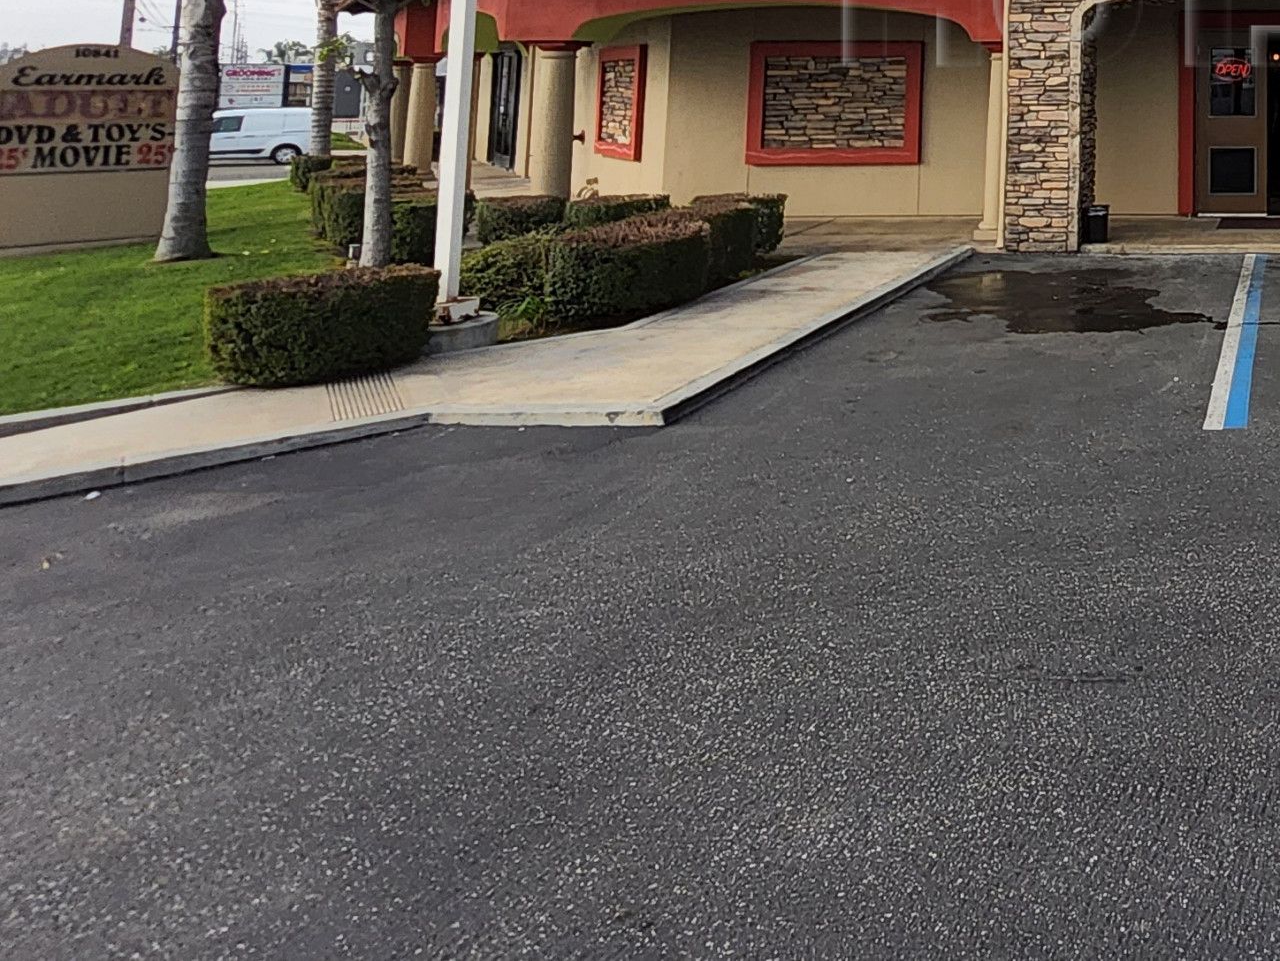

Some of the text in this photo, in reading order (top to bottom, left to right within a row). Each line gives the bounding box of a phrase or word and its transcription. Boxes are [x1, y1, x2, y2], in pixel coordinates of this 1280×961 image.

[75, 48, 119, 58] 10841
[12, 65, 166, 86] Earmark
[1215, 61, 1251, 74] OPEN
[0, 91, 173, 119] ADULT
[0, 124, 56, 144] DVD
[62, 124, 82, 143] &
[31, 145, 131, 168] MOVIE
